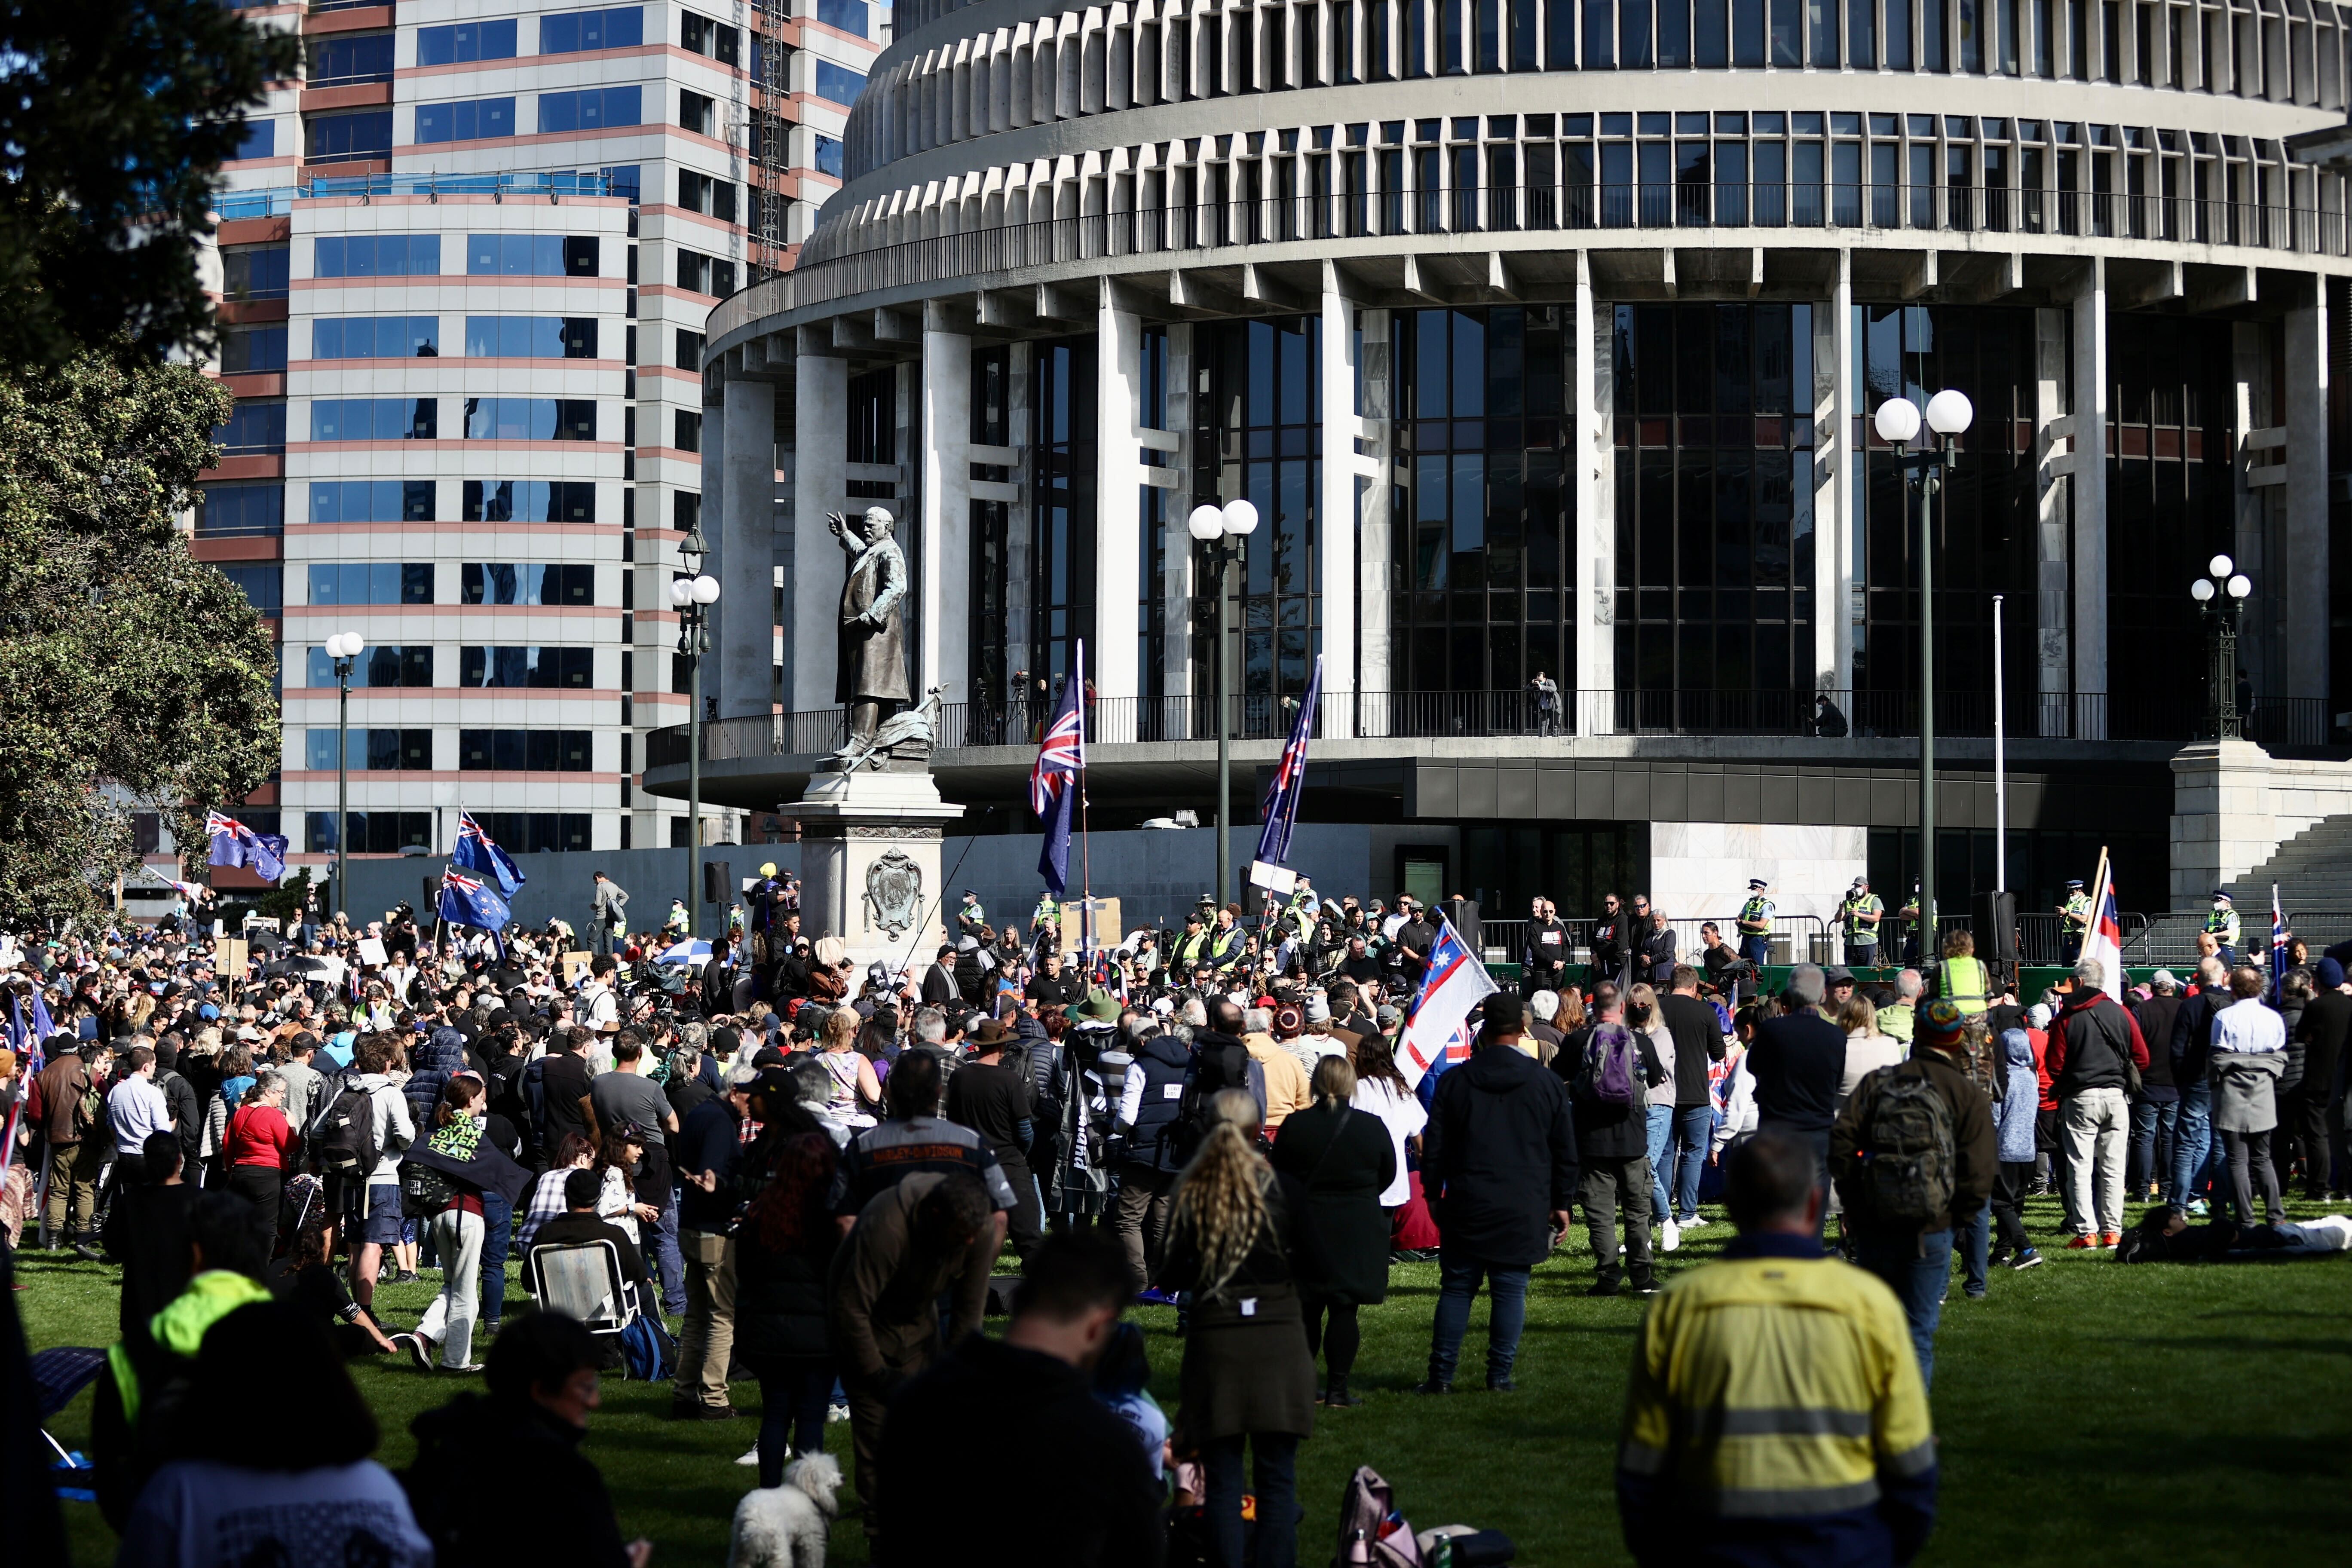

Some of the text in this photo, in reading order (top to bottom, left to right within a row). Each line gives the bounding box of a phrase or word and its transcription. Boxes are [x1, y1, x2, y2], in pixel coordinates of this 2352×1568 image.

[437, 1130, 478, 1149] OVER
[428, 1139, 472, 1160] FEAR
[873, 1145, 964, 1162] HARLEY-DAVIDSON
